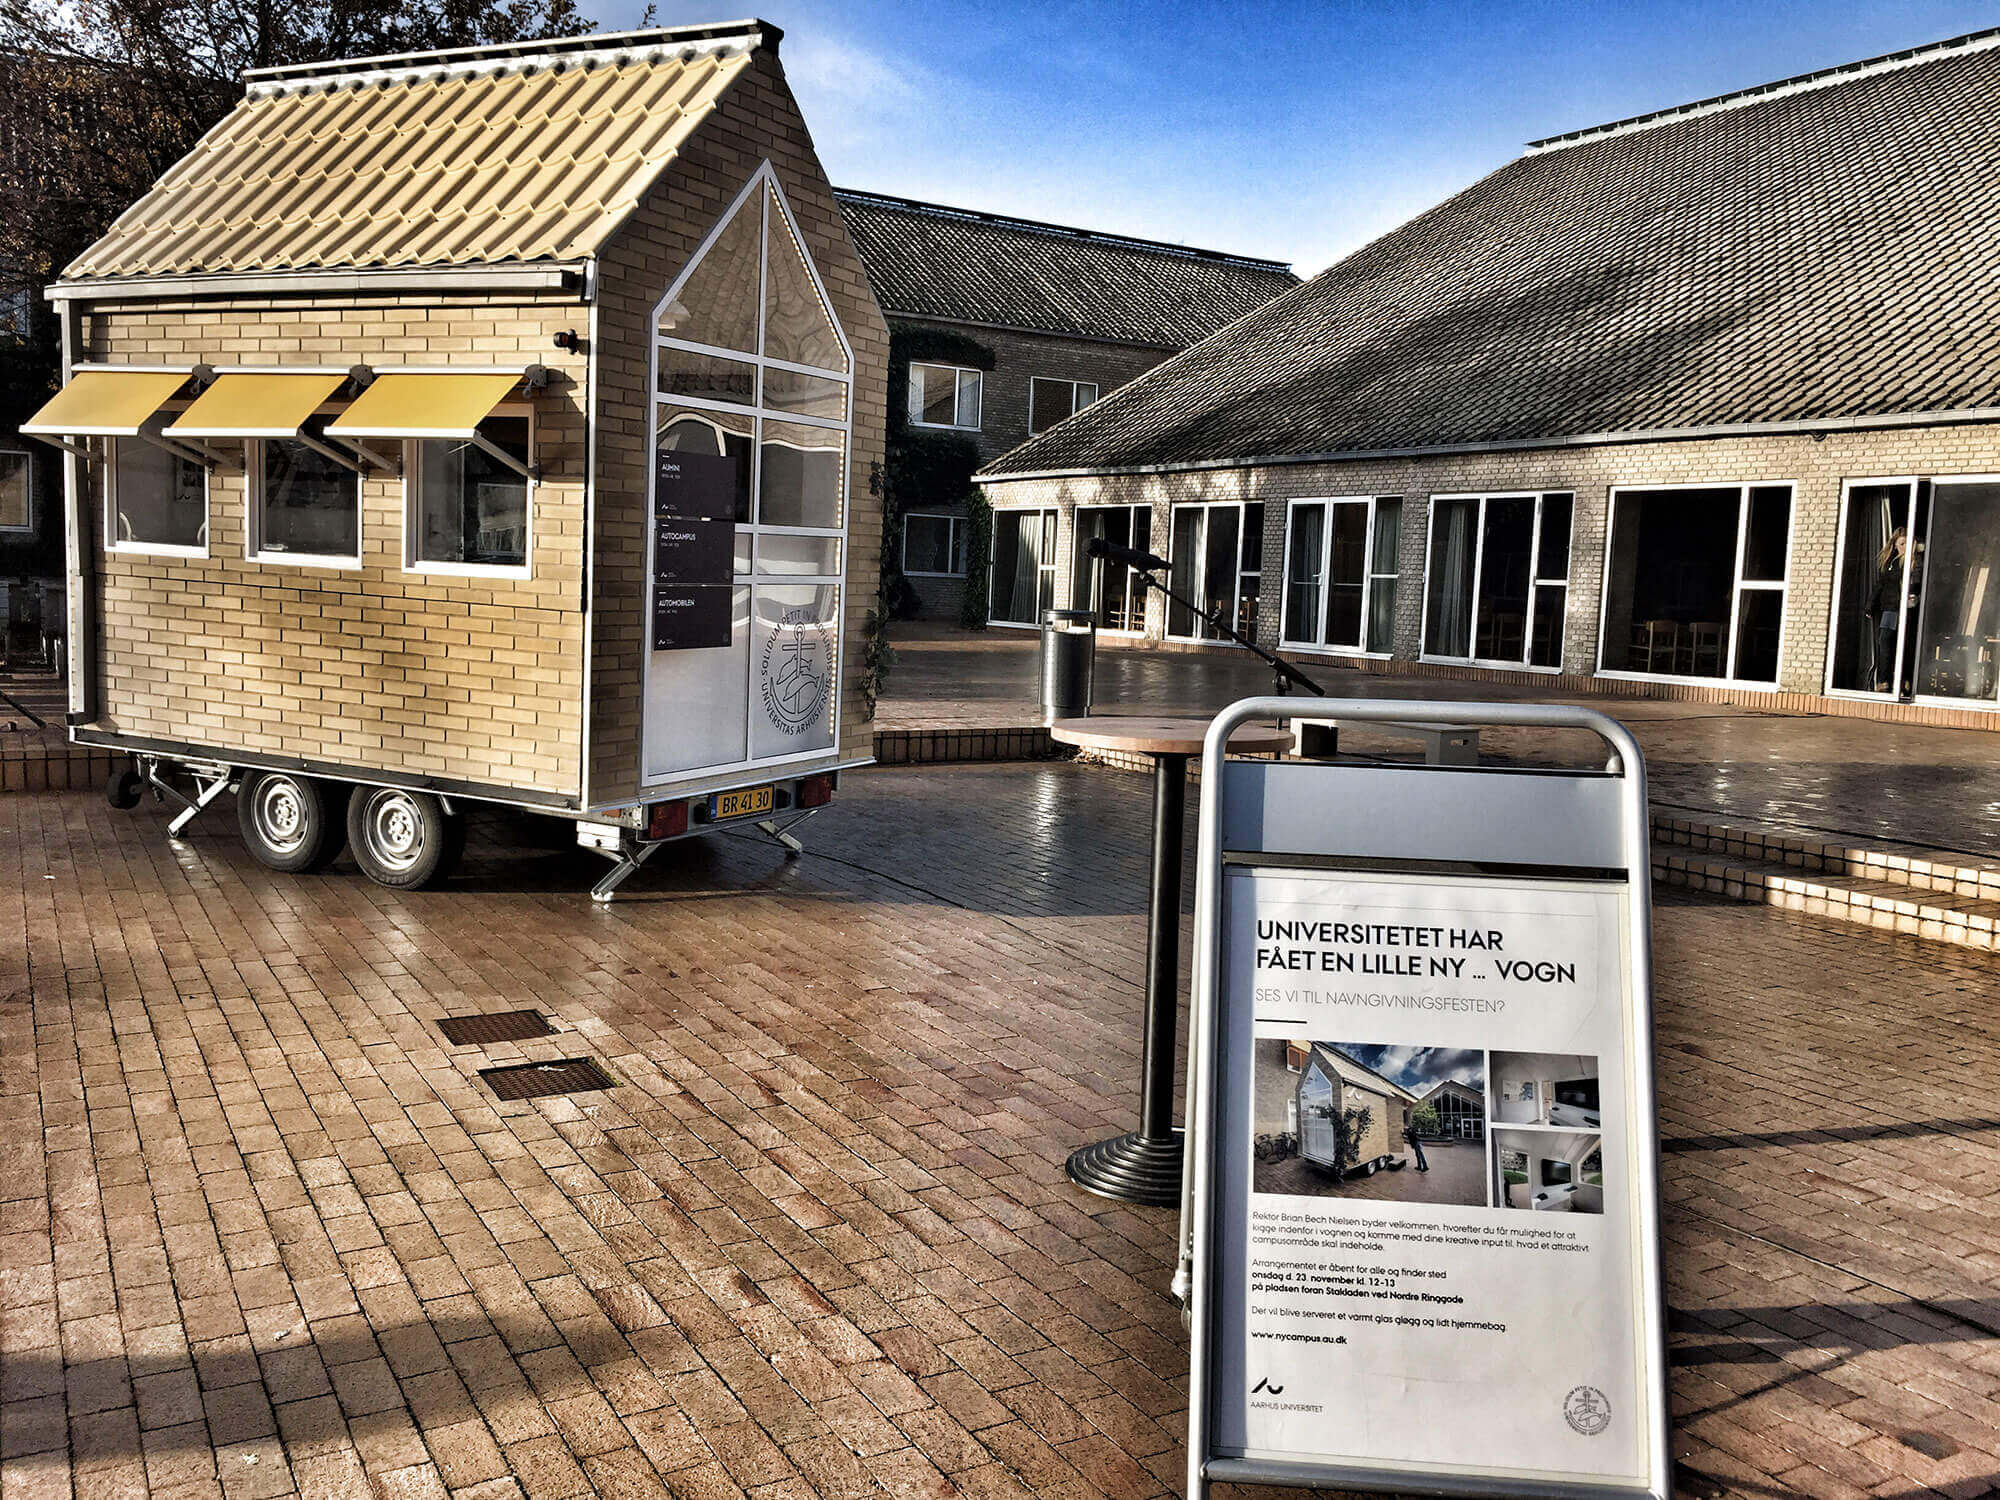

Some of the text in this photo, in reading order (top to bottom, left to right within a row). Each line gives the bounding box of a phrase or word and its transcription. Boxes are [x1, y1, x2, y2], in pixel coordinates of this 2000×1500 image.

[661, 532, 695, 541] AUTOCAMPUS
[658, 599, 695, 607] AUTOMOBILEN
[761, 623, 782, 676] SOLIDUM
[781, 609, 801, 625] PETIT
[813, 615, 832, 671] ROFUNDIS
[761, 682, 794, 736] UNIVERSITAS
[722, 790, 769, 814] BR 41 30
[1257, 919, 1503, 951] UNIVERSITETET HAR
[1257, 946, 1316, 971] FÅET
[1322, 951, 1354, 973] EN
[1362, 953, 1422, 976] LILLE
[1430, 957, 1466, 978] NY
[1495, 959, 1576, 984] VOGN
[1255, 988, 1505, 1013] SES VI TIL NAVNGIVNINGSFESTEN?
[1252, 1211, 1280, 1222] Rektor
[1281, 1213, 1303, 1223] Brian
[1305, 1214, 1327, 1224] Bech
[1329, 1216, 1360, 1226] Nielsen
[1362, 1218, 1387, 1229] byder
[1443, 1223, 1481, 1234] hvorefter
[1483, 1226, 1495, 1235] du
[1497, 1226, 1508, 1236] får
[1510, 1228, 1551, 1240] mulighed
[1553, 1230, 1565, 1240] for
[1566, 1231, 1576, 1240] at
[1252, 1223, 1276, 1233] kigge
[1278, 1225, 1314, 1235] indenfor
[1320, 1229, 1352, 1239] vognen
[1354, 1230, 1366, 1240] og
[1367, 1231, 1400, 1241] komme
[1402, 1233, 1422, 1242] med
[1424, 1234, 1444, 1243] dine
[1445, 1235, 1479, 1246] kreative
[1481, 1238, 1503, 1248] input
[1516, 1241, 1539, 1250] hvad
[1540, 1242, 1550, 1250] et
[1551, 1243, 1589, 1253] attraktivt
[1252, 1235, 1320, 1248] campusområde
[1321, 1239, 1338, 1249] skal
[1252, 1259, 1447, 1279] Arrangementet er åbent for alle og finder sted
[1252, 1272, 1284, 1282] onsdag
[1310, 1275, 1354, 1285] november
[1369, 1278, 1395, 1288] 12-13
[1252, 1282, 1464, 1305] på pladsen foran Stakladen ved Nordre Ringgade
[1252, 1306, 1267, 1315] Der
[1268, 1307, 1278, 1316] vil
[1280, 1308, 1300, 1317] blive
[1302, 1310, 1336, 1320] serveret
[1348, 1314, 1373, 1322] varmt
[1375, 1315, 1394, 1325] glas
[1394, 1316, 1420, 1327] gløgg
[1422, 1318, 1434, 1328] og
[1436, 1317, 1450, 1327] lidt
[1251, 1331, 1348, 1345] www.nycampus.au.dk
[1250, 1401, 1323, 1413] AARHUS UNIVERSITET
